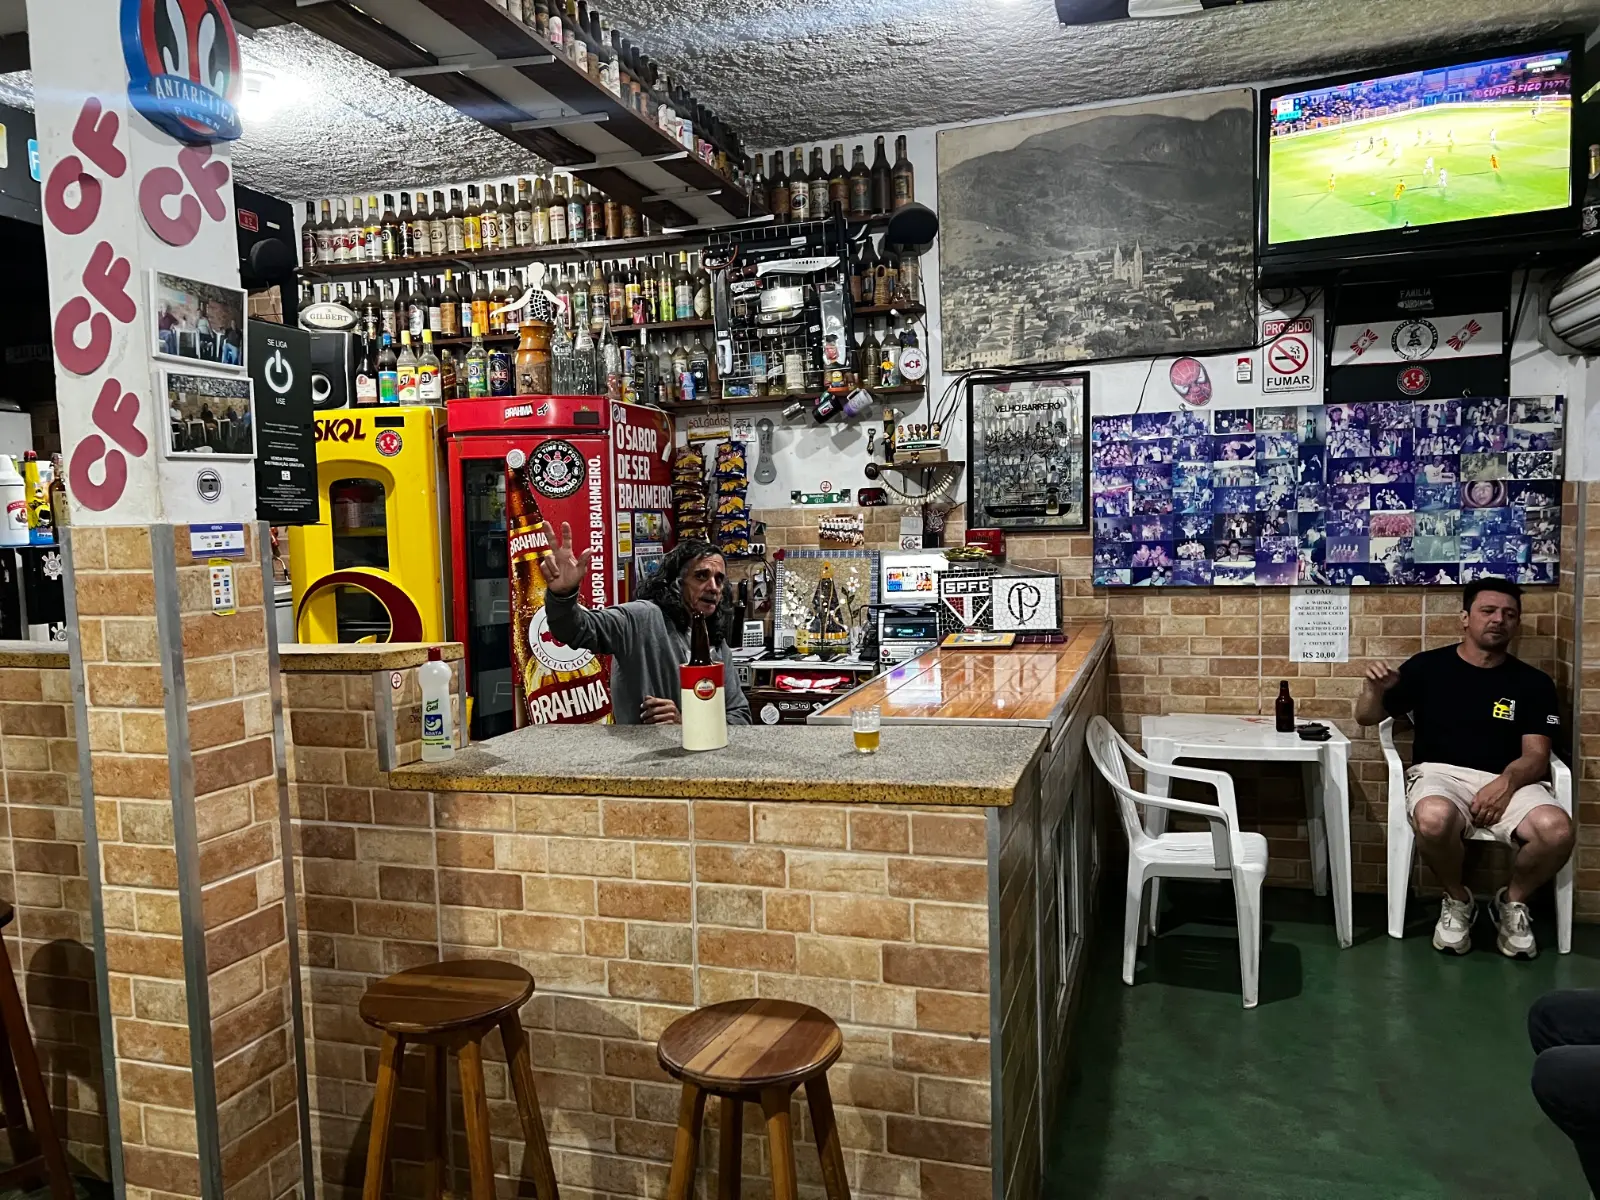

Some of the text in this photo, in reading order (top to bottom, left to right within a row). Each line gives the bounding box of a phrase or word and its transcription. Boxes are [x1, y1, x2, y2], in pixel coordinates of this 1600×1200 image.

[1483, 85, 1515, 98] SUPER
[155, 77, 236, 127] ANTARCTICA
[174, 105, 222, 131] PILSEN
[309, 312, 349, 323] GILBERT
[1265, 320, 1312, 335] PROBIDO
[267, 338, 288, 349] SE LIGA
[1266, 375, 1310, 387] FUMAR
[275, 397, 286, 406] USE
[504, 404, 533, 419] BRAHMA
[994, 402, 1061, 413] VELHO BARREIRO
[314, 418, 367, 443] SKOL
[616, 423, 658, 454] O SABOR
[542, 445, 556, 454] TIME
[567, 450, 580, 466] POVO
[617, 454, 651, 481] DE SER
[618, 483, 673, 509] BRAHMEIRO
[510, 532, 549, 557] BRAHMA
[590, 531, 604, 552] SER
[591, 555, 605, 575] DE
[592, 576, 605, 611] SABOR
[945, 581, 990, 594] SPFC
[425, 702, 439, 713] Gel
[530, 679, 610, 725] BRAHMA
